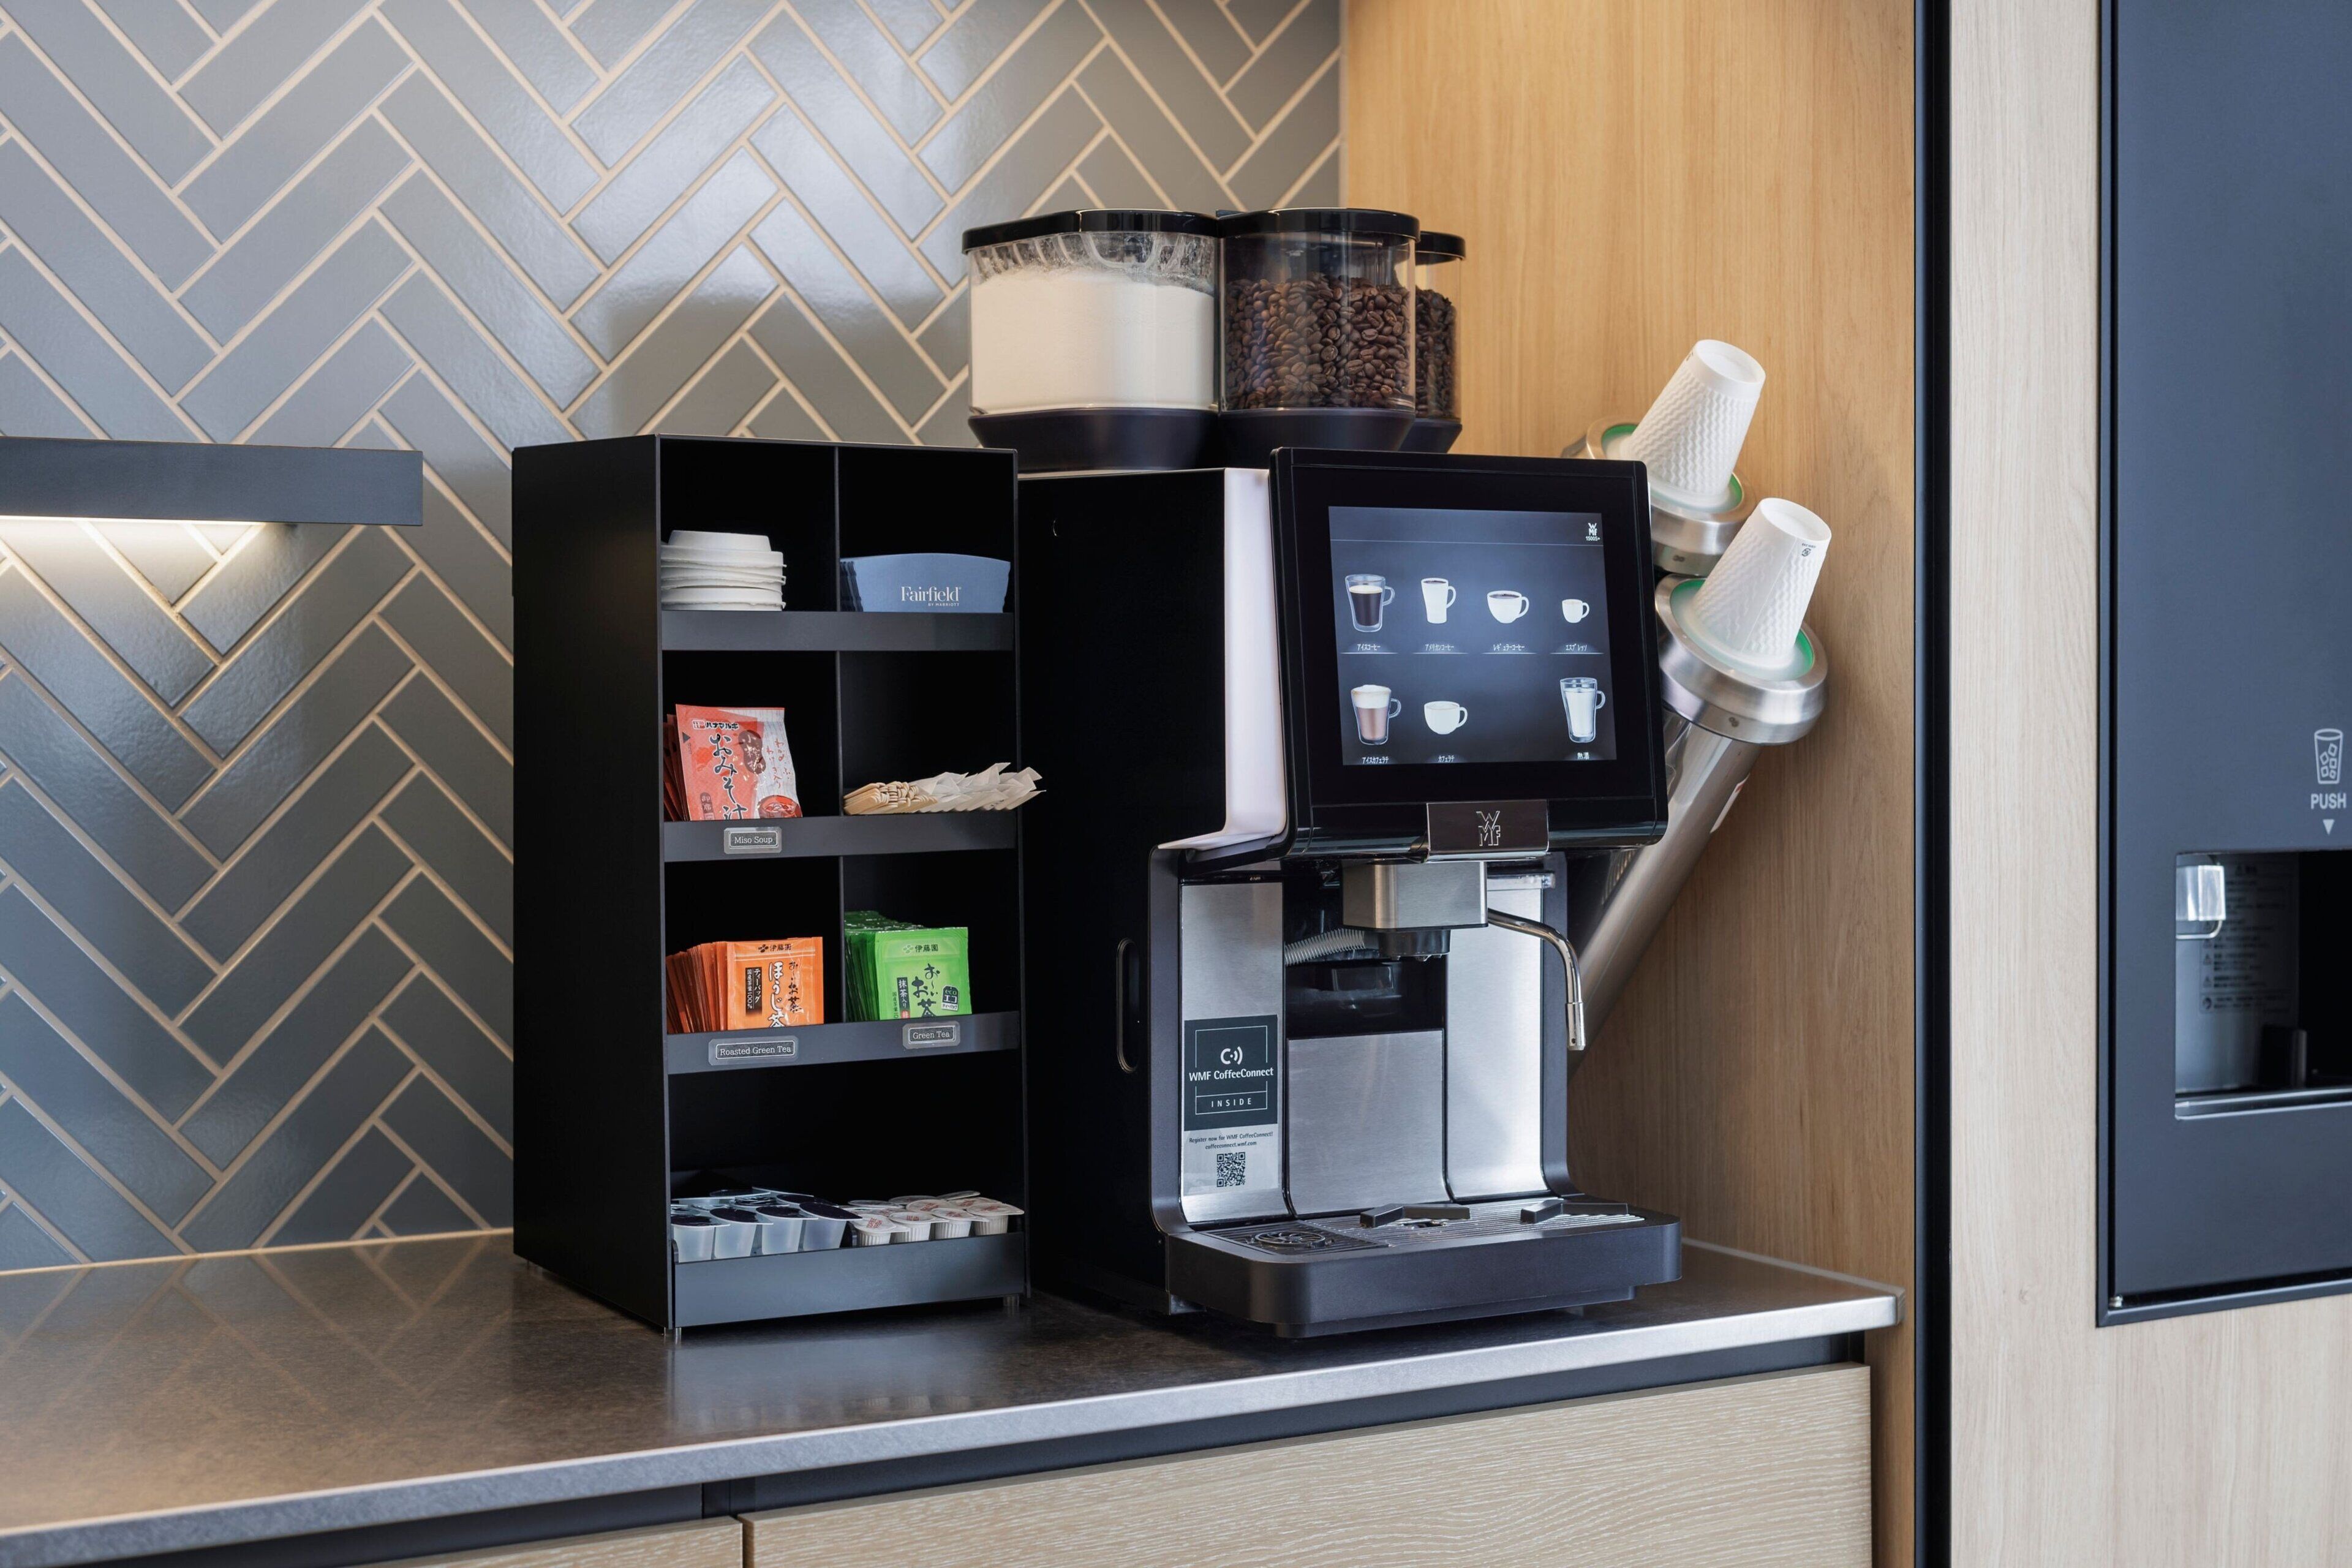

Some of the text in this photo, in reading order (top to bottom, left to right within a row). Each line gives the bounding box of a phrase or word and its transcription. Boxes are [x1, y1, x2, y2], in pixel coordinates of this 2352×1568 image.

[1588, 522, 1597, 536] WMF
[901, 586, 959, 601] Fairfield
[2311, 793, 2346, 809] PUSH
[1476, 810, 1501, 846] WMF
[914, 944, 938, 953] 伊藤園
[767, 960, 785, 1027] ほうじ茶
[898, 979, 909, 1008] 抹茶入り
[943, 995, 957, 1003] エコ
[913, 1030, 935, 1039] Green
[1189, 1067, 1273, 1081] WMF CoffeeConnect
[1211, 1098, 1251, 1107] INSIDE
[1205, 1140, 1257, 1150] coffeeconnect.wmf.com
